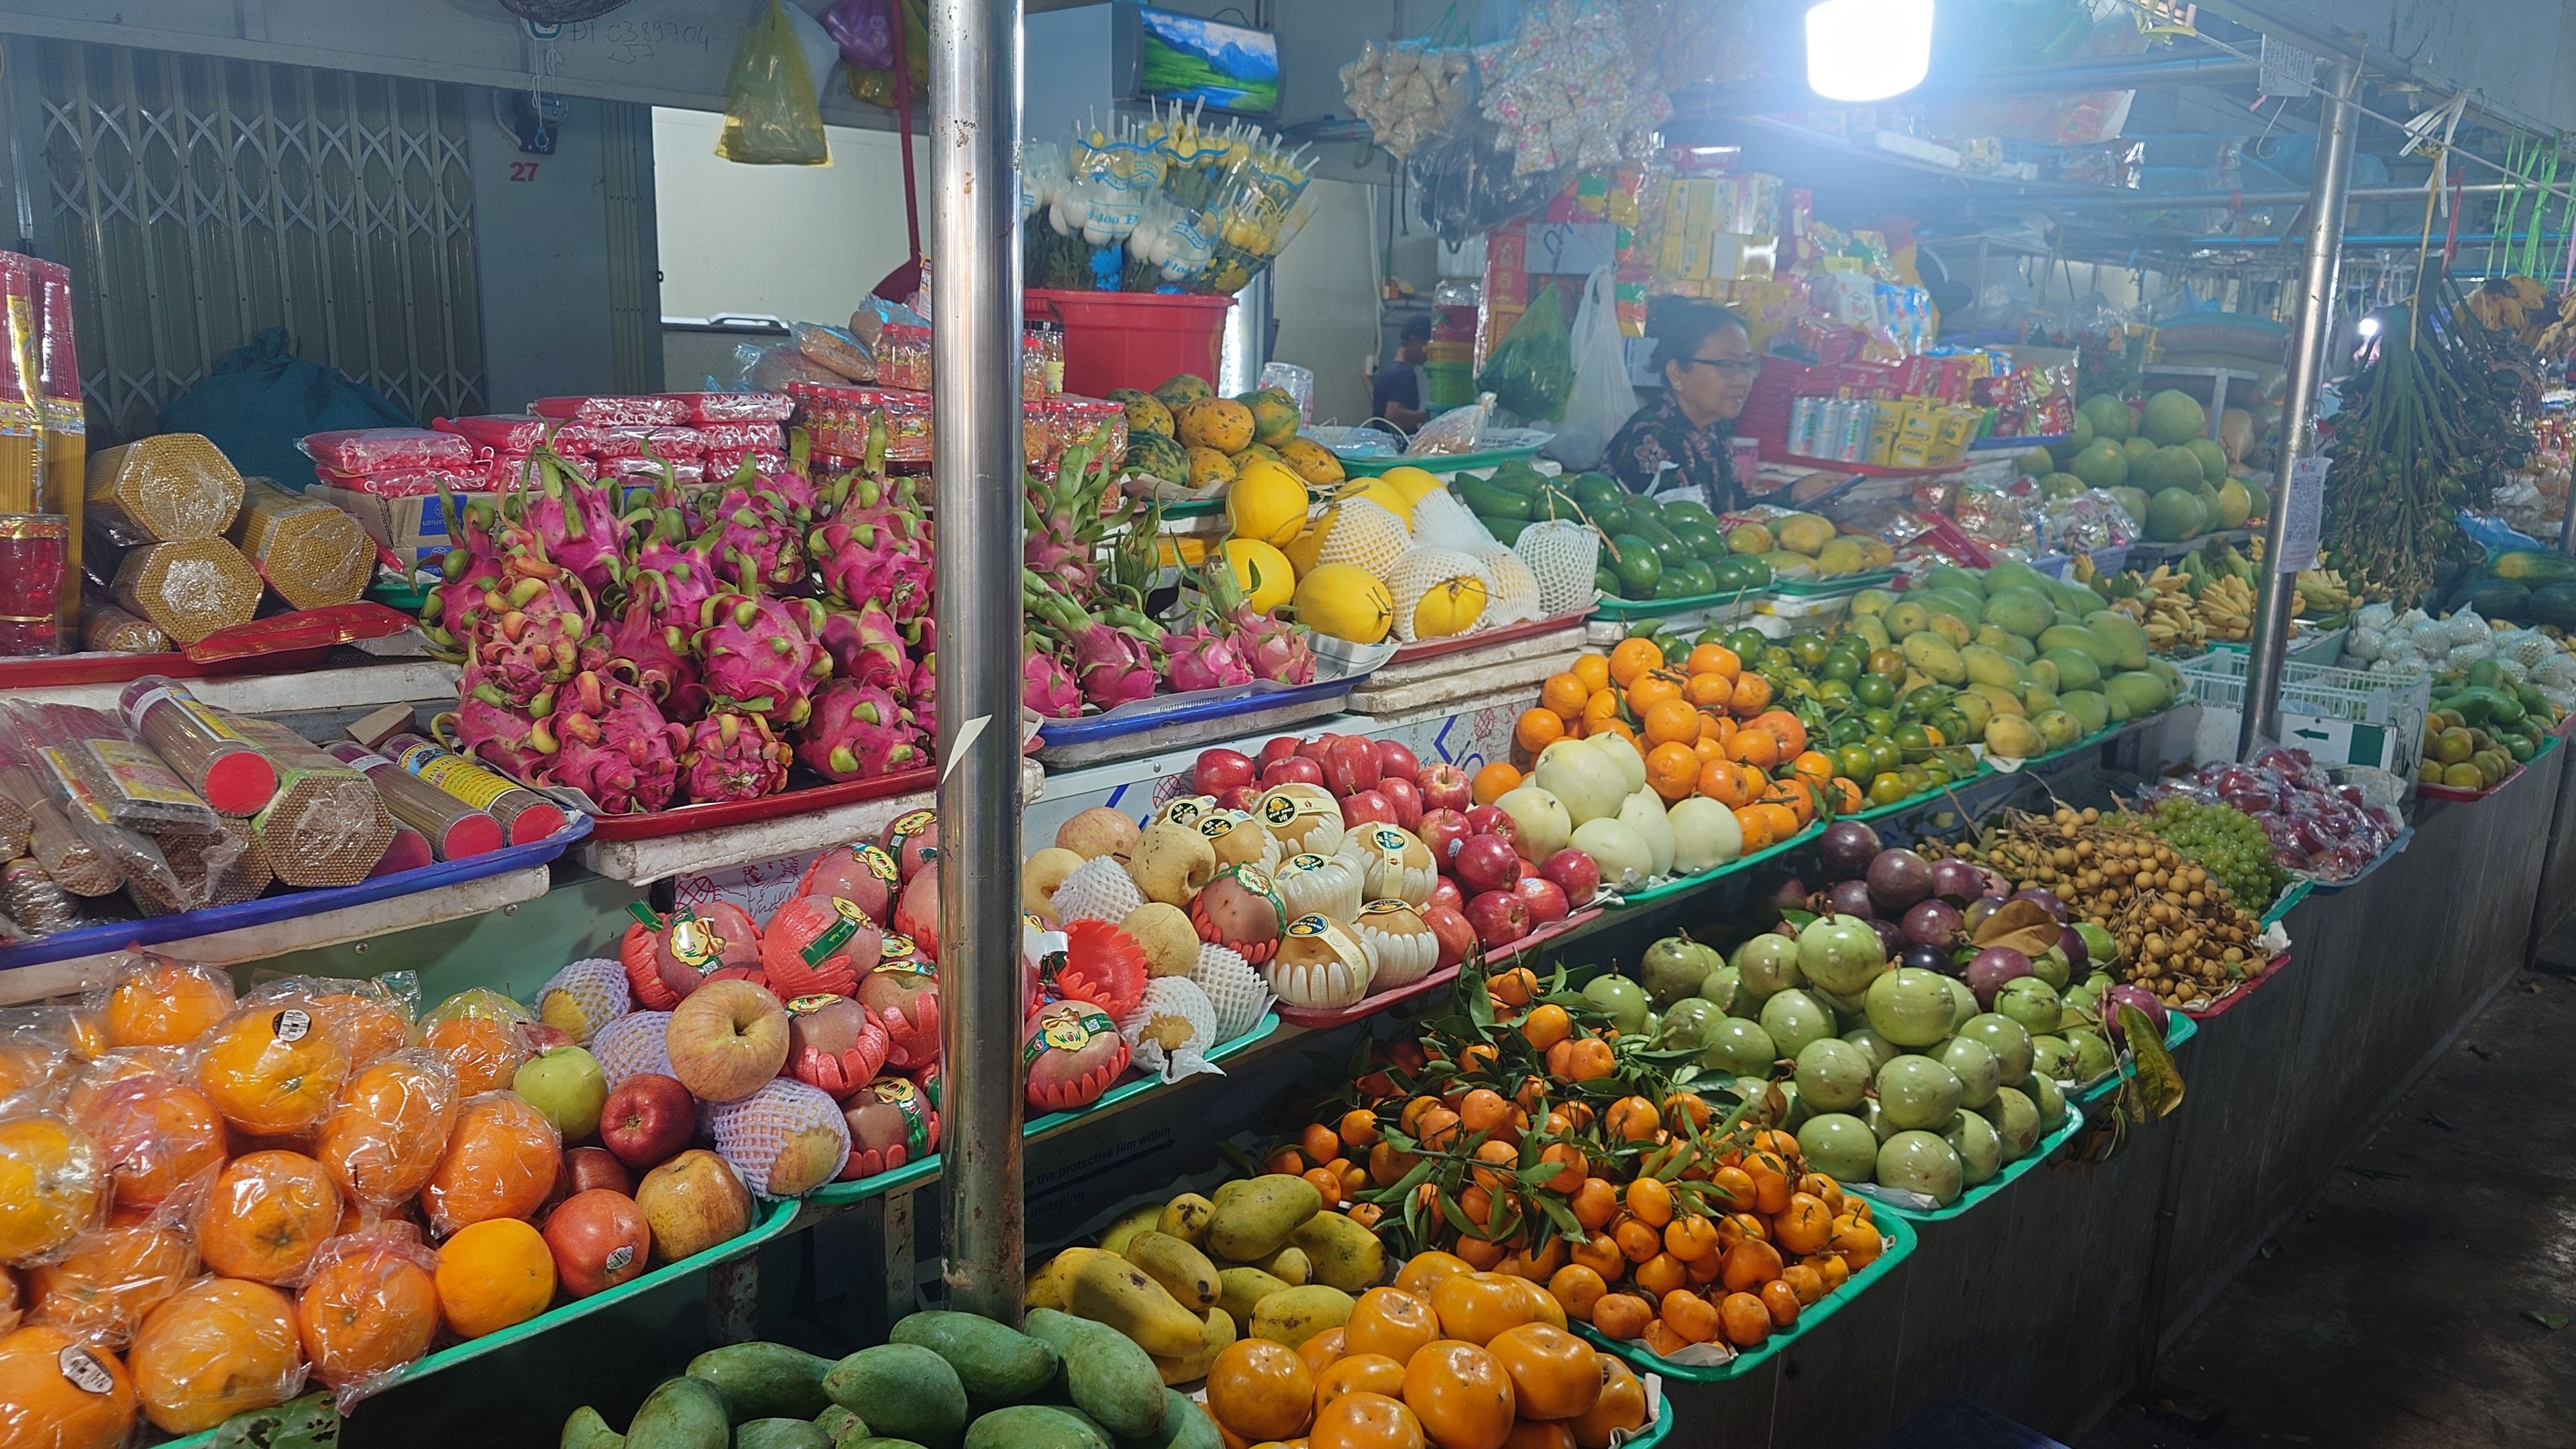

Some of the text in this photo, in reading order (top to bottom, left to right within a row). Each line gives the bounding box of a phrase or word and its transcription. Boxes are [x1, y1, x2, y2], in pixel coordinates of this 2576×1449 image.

[511, 162, 539, 182] 27
[1037, 1171, 1055, 1185] the
[1059, 1149, 1114, 1180] protective
[1116, 1140, 1136, 1155] film
[1138, 1126, 1171, 1146] within
[1030, 1190, 1085, 1218] installing
